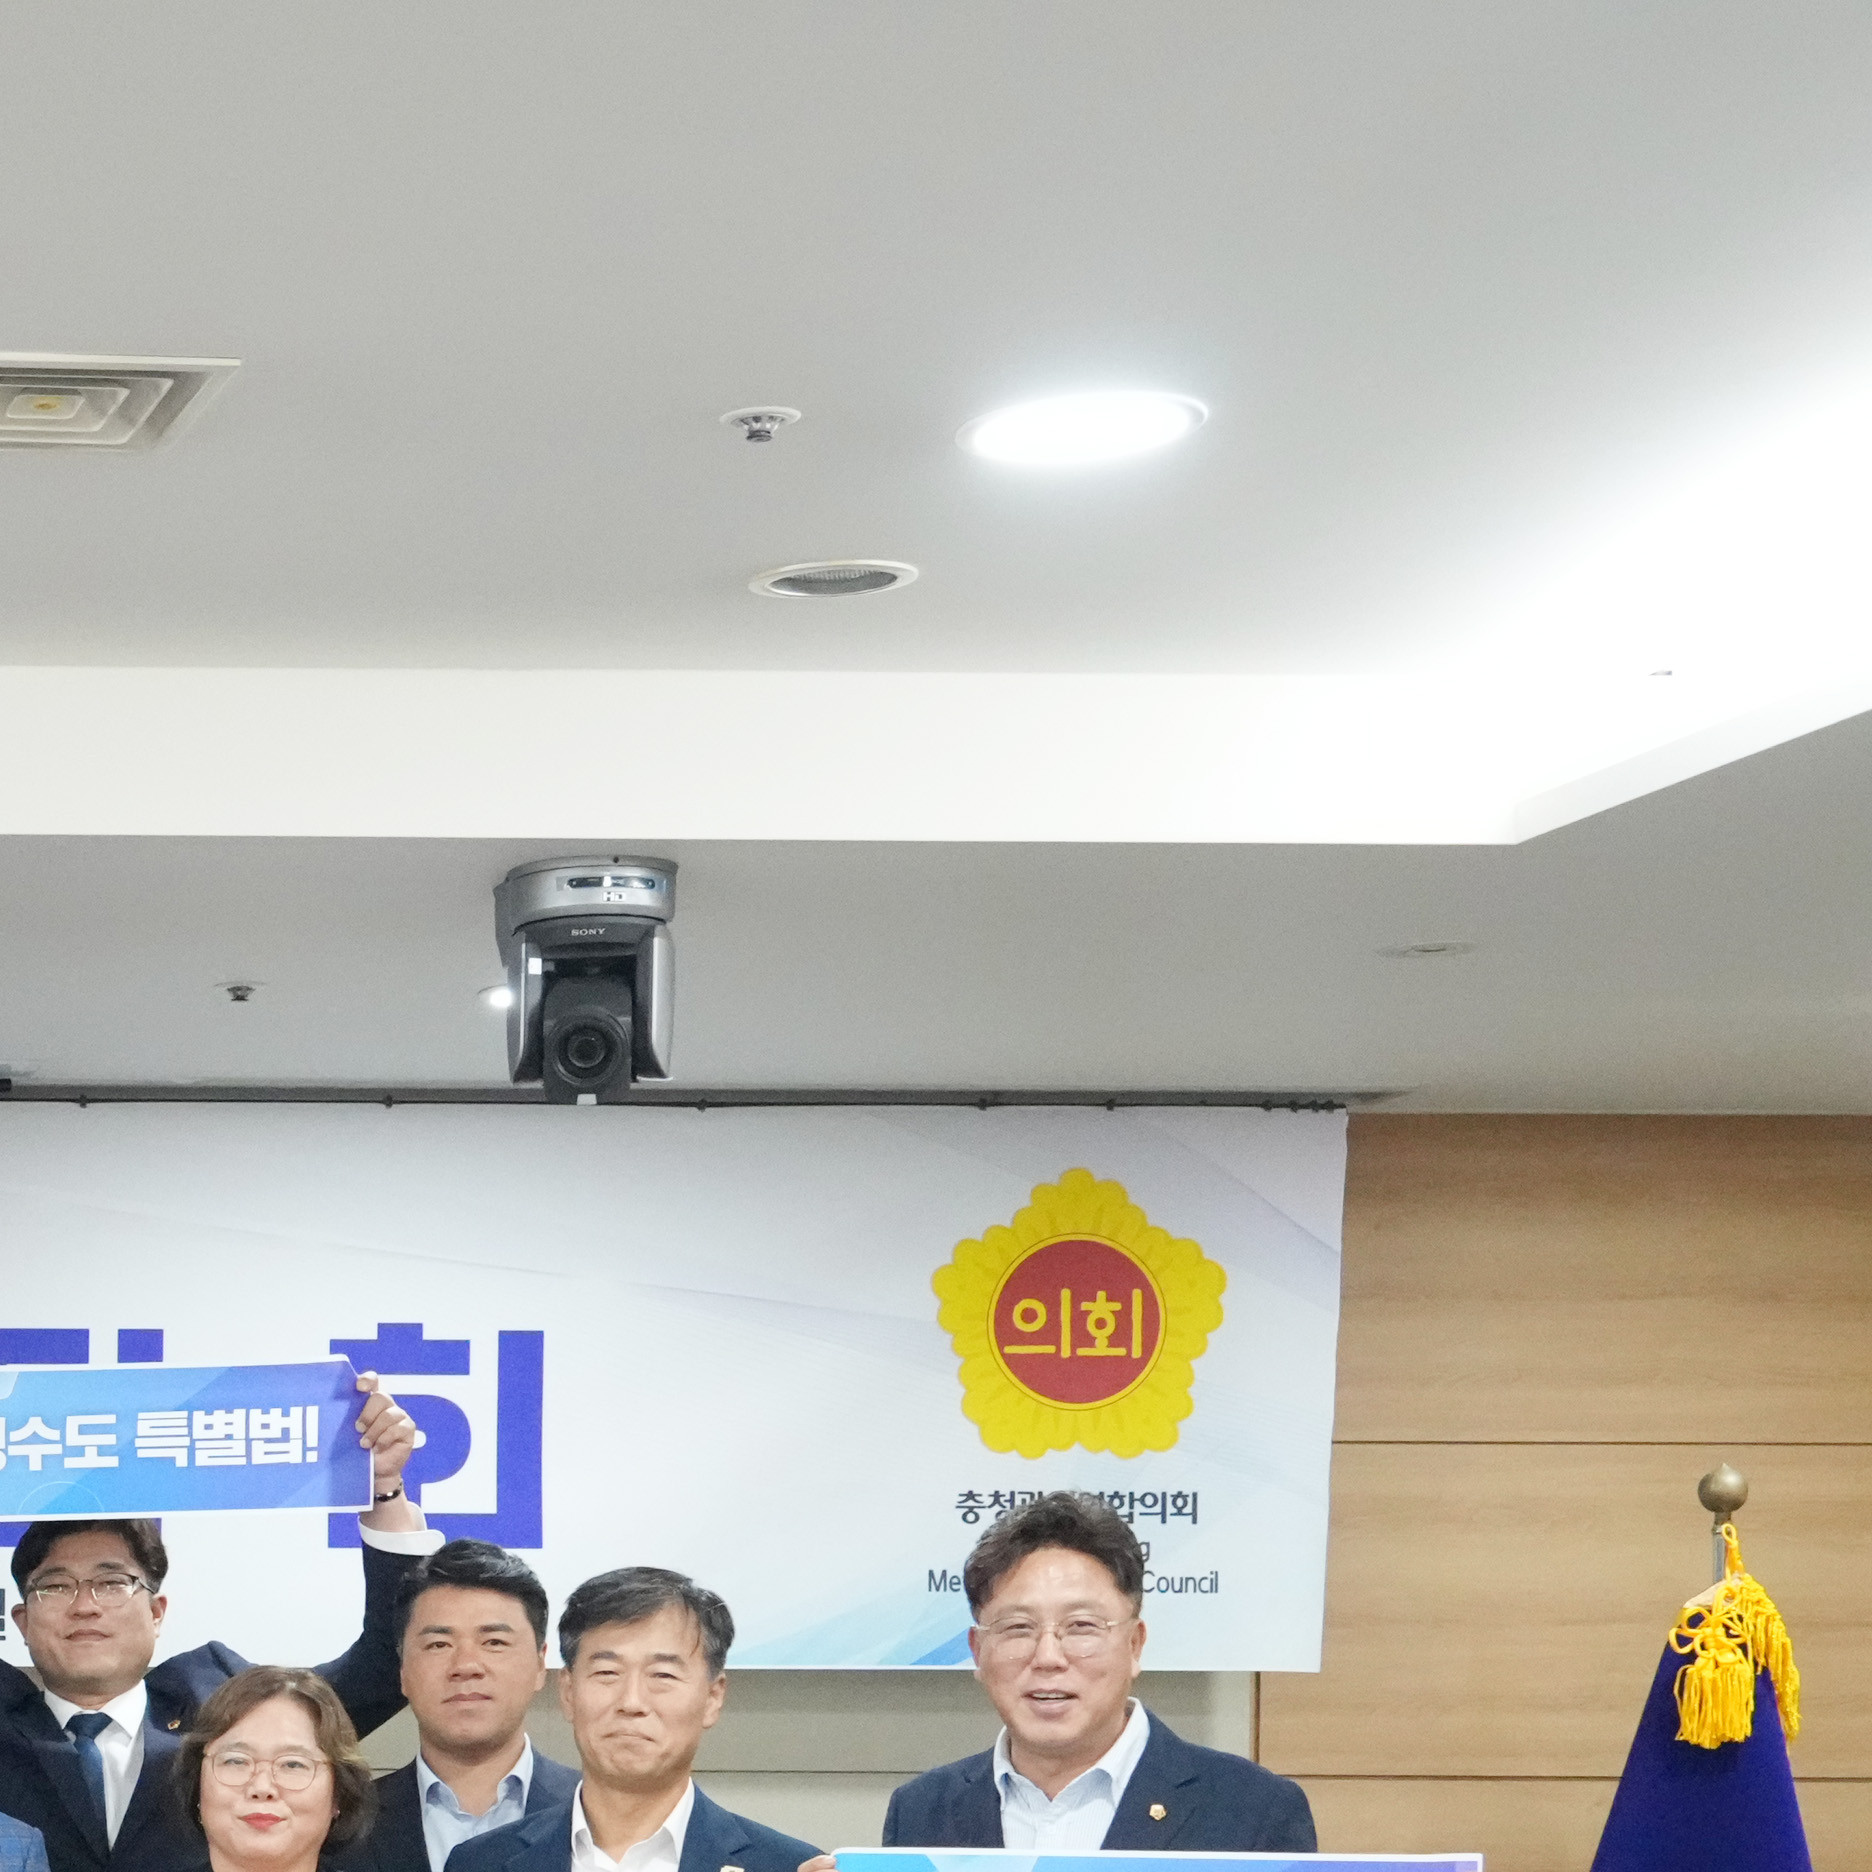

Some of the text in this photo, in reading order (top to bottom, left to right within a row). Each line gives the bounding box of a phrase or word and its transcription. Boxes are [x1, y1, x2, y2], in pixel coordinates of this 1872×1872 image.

[571, 927, 605, 937] SONY
[1003, 1288, 1143, 1358] 의회
[135, 1406, 319, 1467] 특별법!
[956, 1490, 1198, 1525] 충청합의회
[1143, 1571, 1219, 1594] Council
